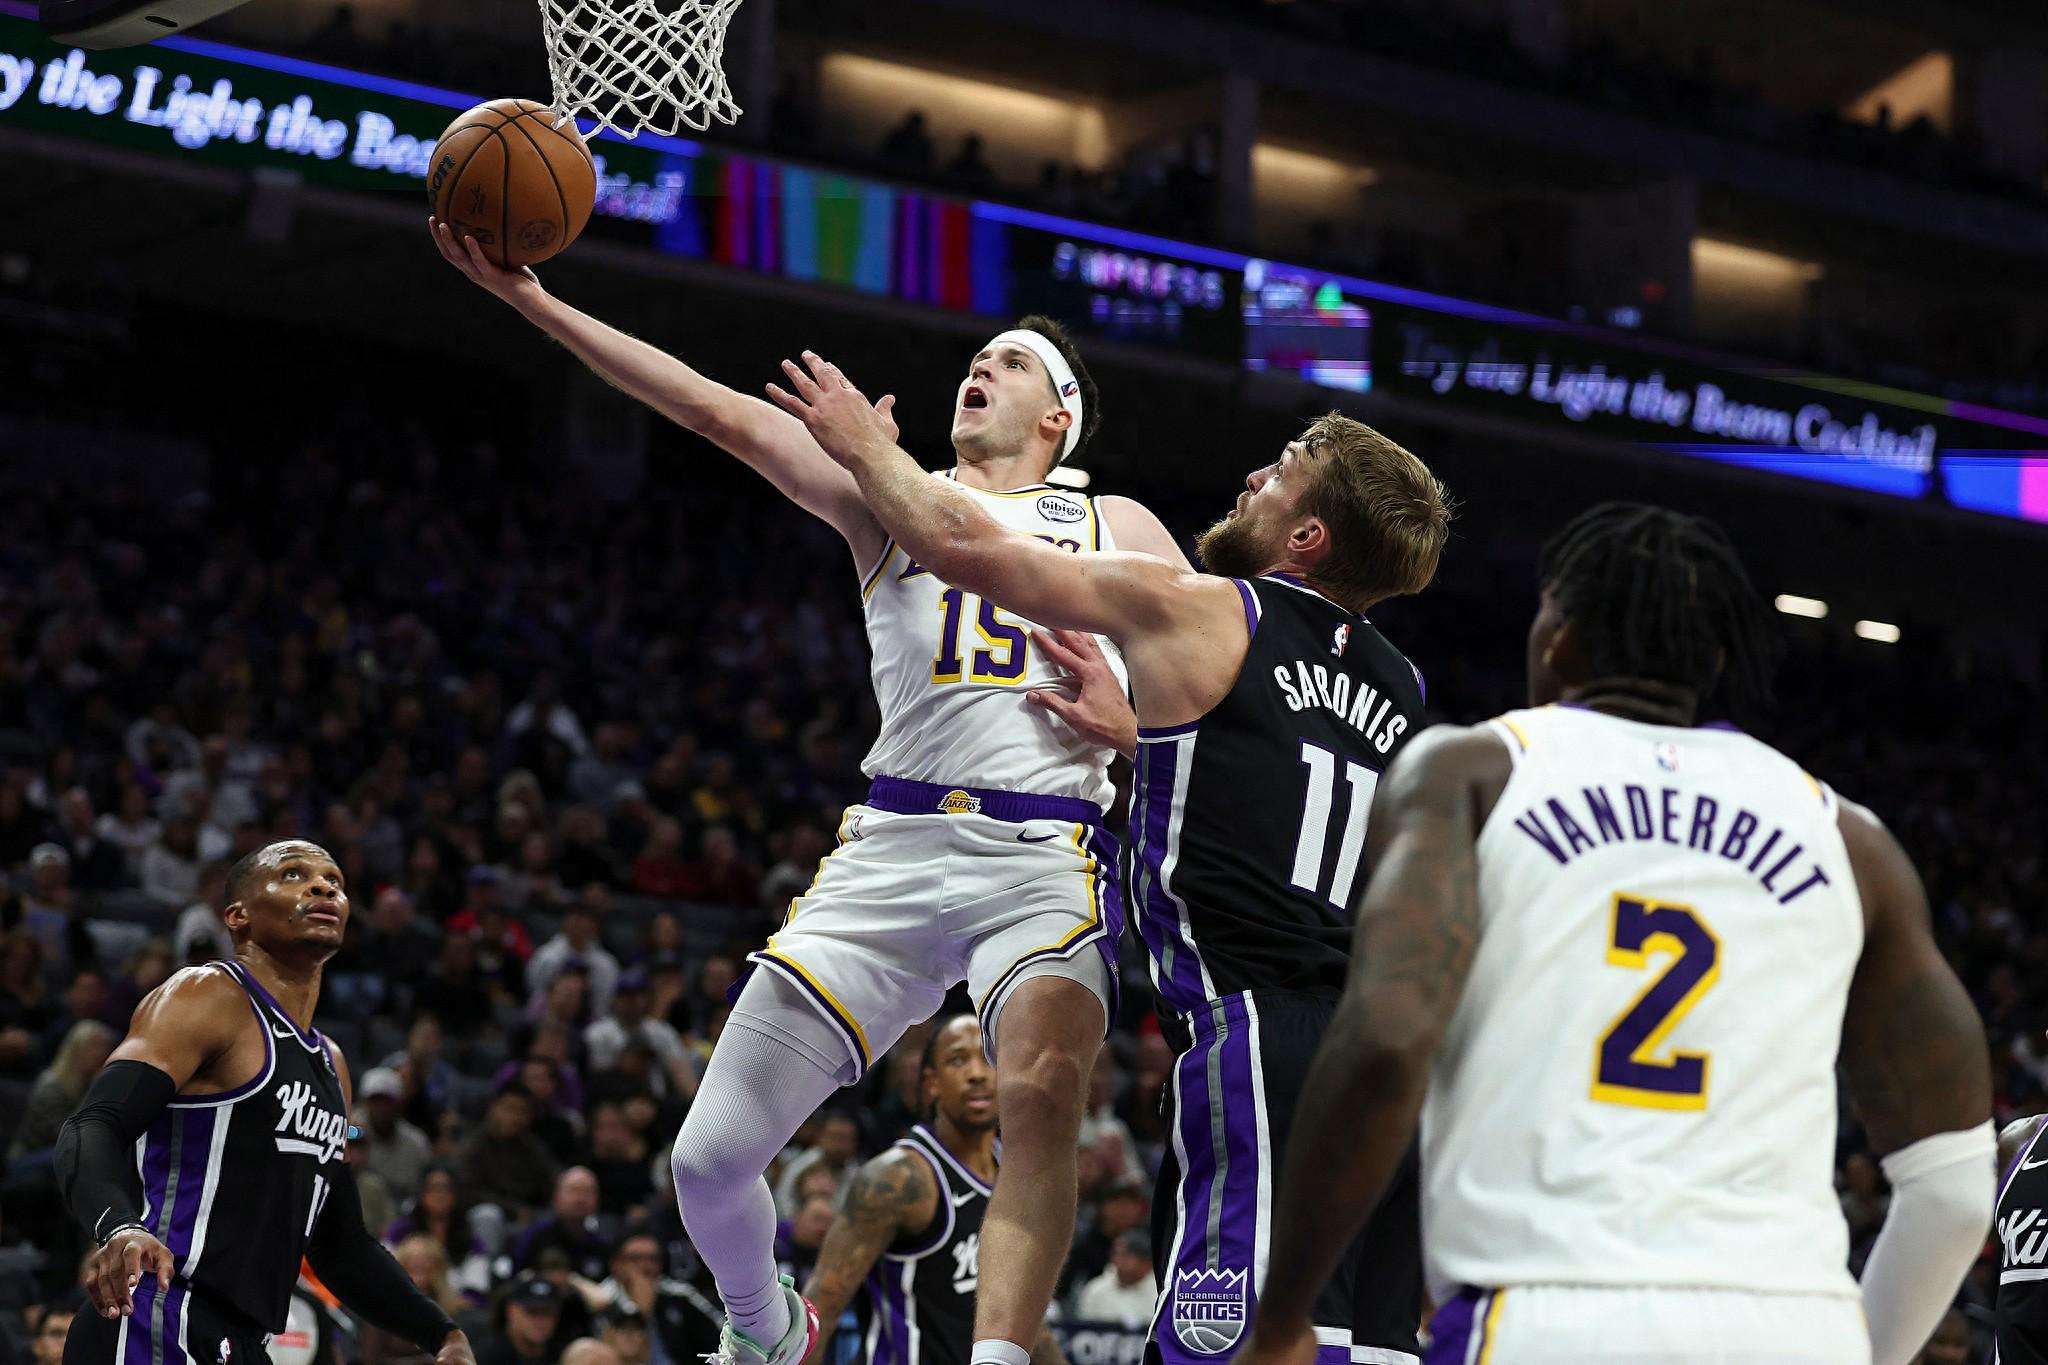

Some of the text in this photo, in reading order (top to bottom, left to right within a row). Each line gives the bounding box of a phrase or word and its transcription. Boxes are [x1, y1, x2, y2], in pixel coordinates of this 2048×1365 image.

[38, 48, 123, 115] the
[124, 65, 262, 150] Light
[264, 94, 348, 160] the
[1629, 369, 1691, 428] the
[1042, 500, 1082, 516] bibigo
[931, 584, 1031, 686] 15
[1274, 660, 1407, 754] SABONIS
[940, 796, 978, 813] LAKERS
[1290, 740, 1380, 911] 11
[1515, 784, 1830, 906] VANDERBILT
[1588, 890, 1724, 1111] 2
[1176, 1303, 1243, 1320] KINGS
[1179, 1292, 1241, 1300] SACRAMENTO
